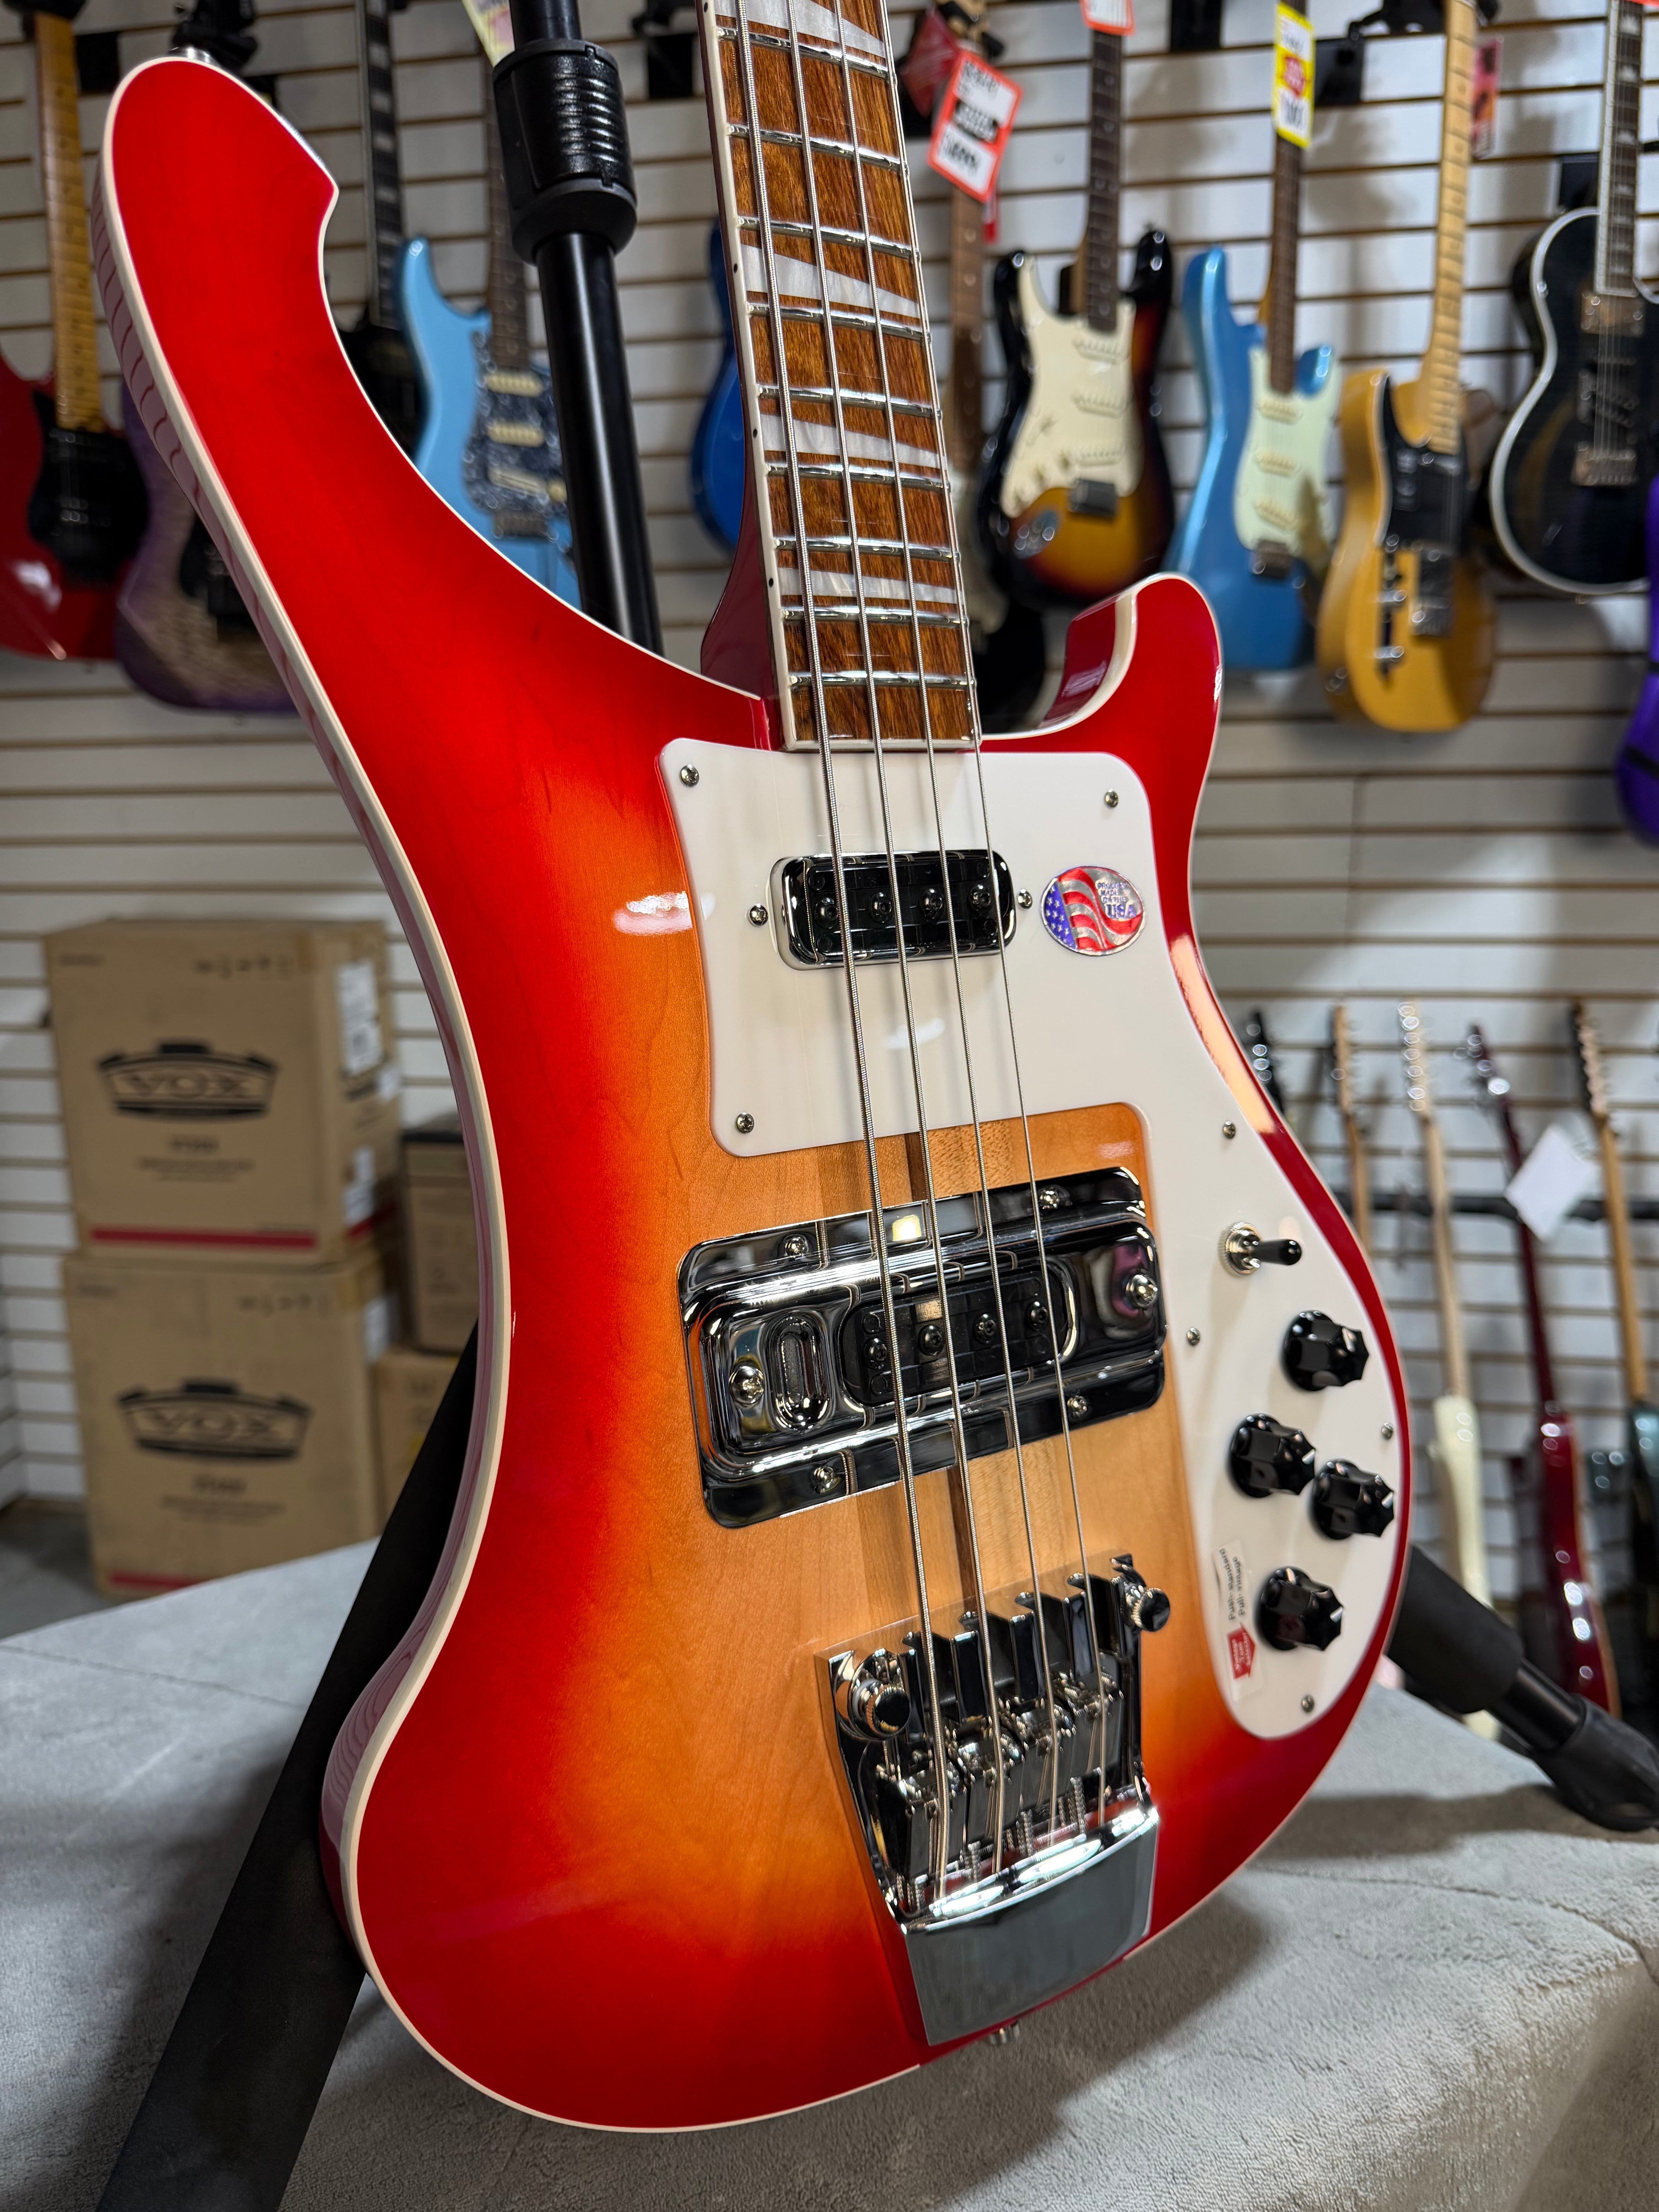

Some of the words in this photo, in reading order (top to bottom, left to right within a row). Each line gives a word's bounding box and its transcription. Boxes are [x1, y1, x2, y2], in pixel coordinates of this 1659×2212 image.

[1105, 903, 1137, 919] USA
[1219, 1548, 1235, 1590] standard
[1232, 1556, 1242, 1591] vintage
